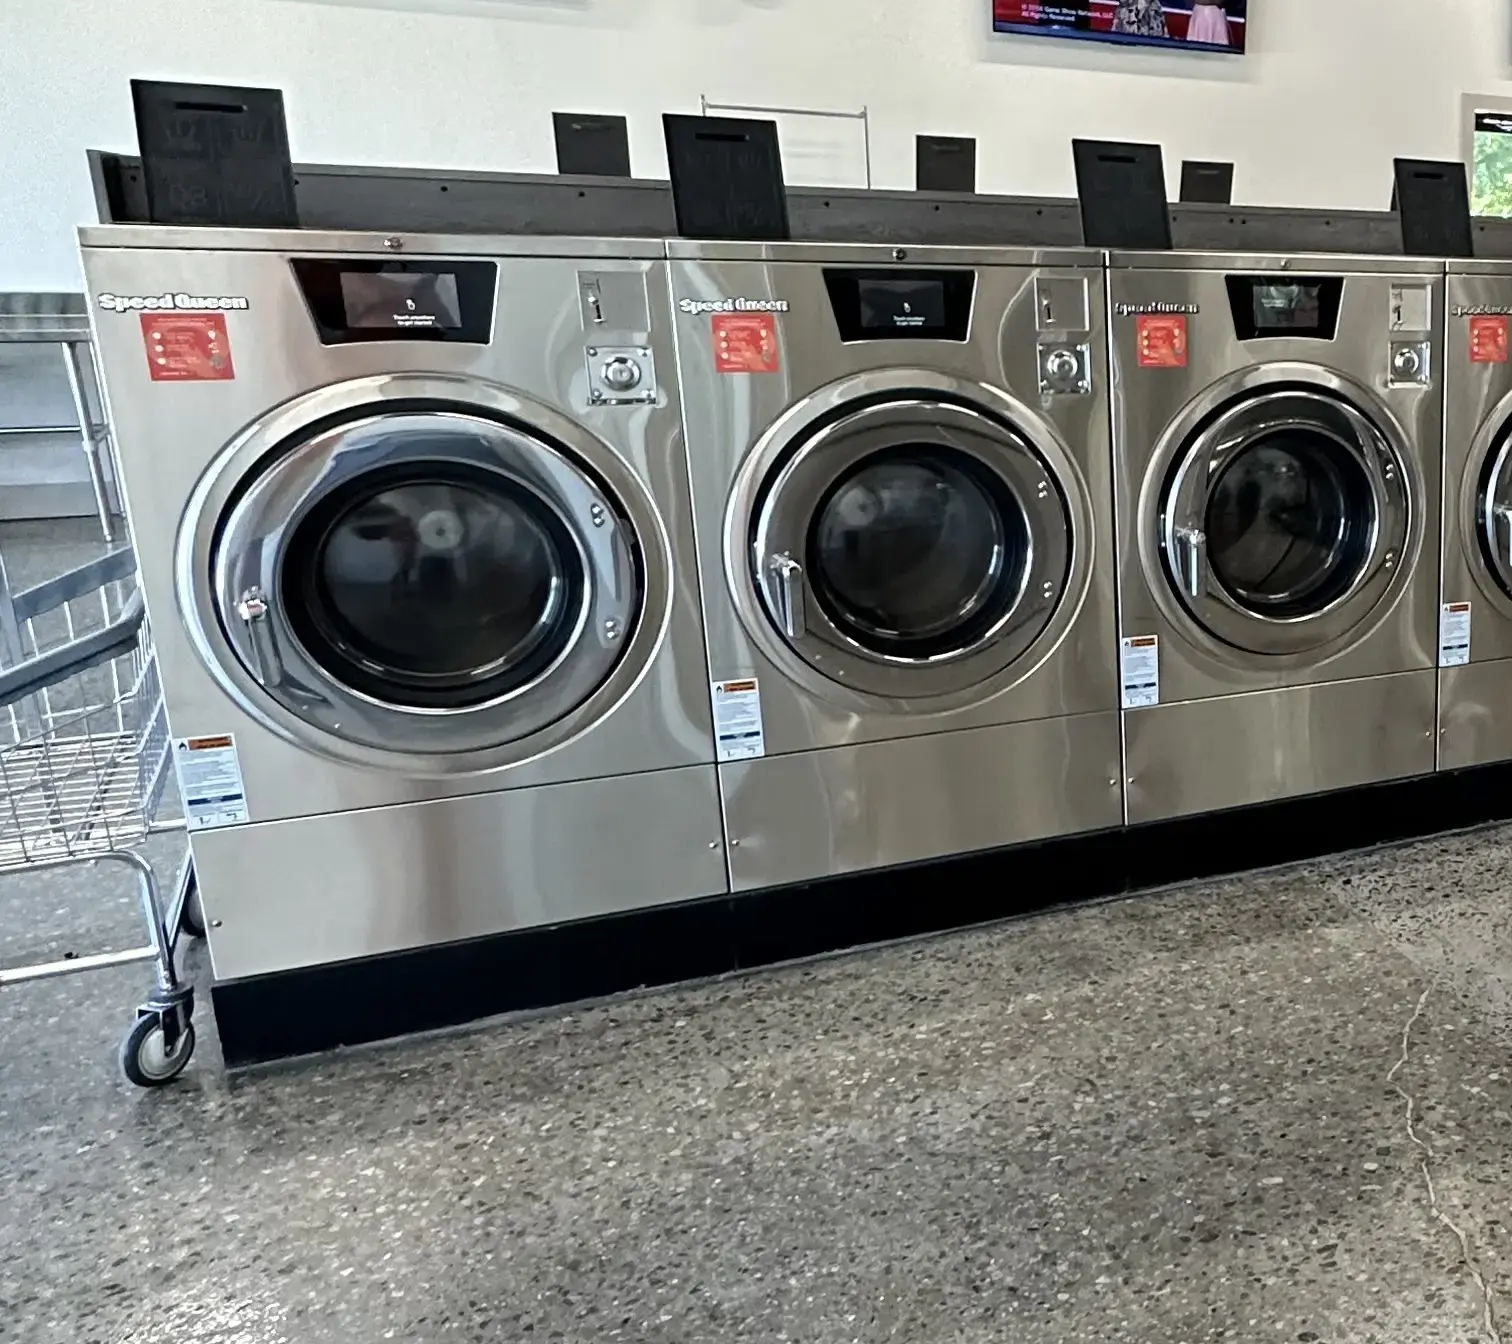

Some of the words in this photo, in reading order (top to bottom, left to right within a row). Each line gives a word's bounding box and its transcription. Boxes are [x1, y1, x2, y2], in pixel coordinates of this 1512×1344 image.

[98, 293, 176, 313] Speed
[174, 292, 249, 310] Queen
[680, 298, 734, 315] Speed
[735, 297, 789, 312] Queen
